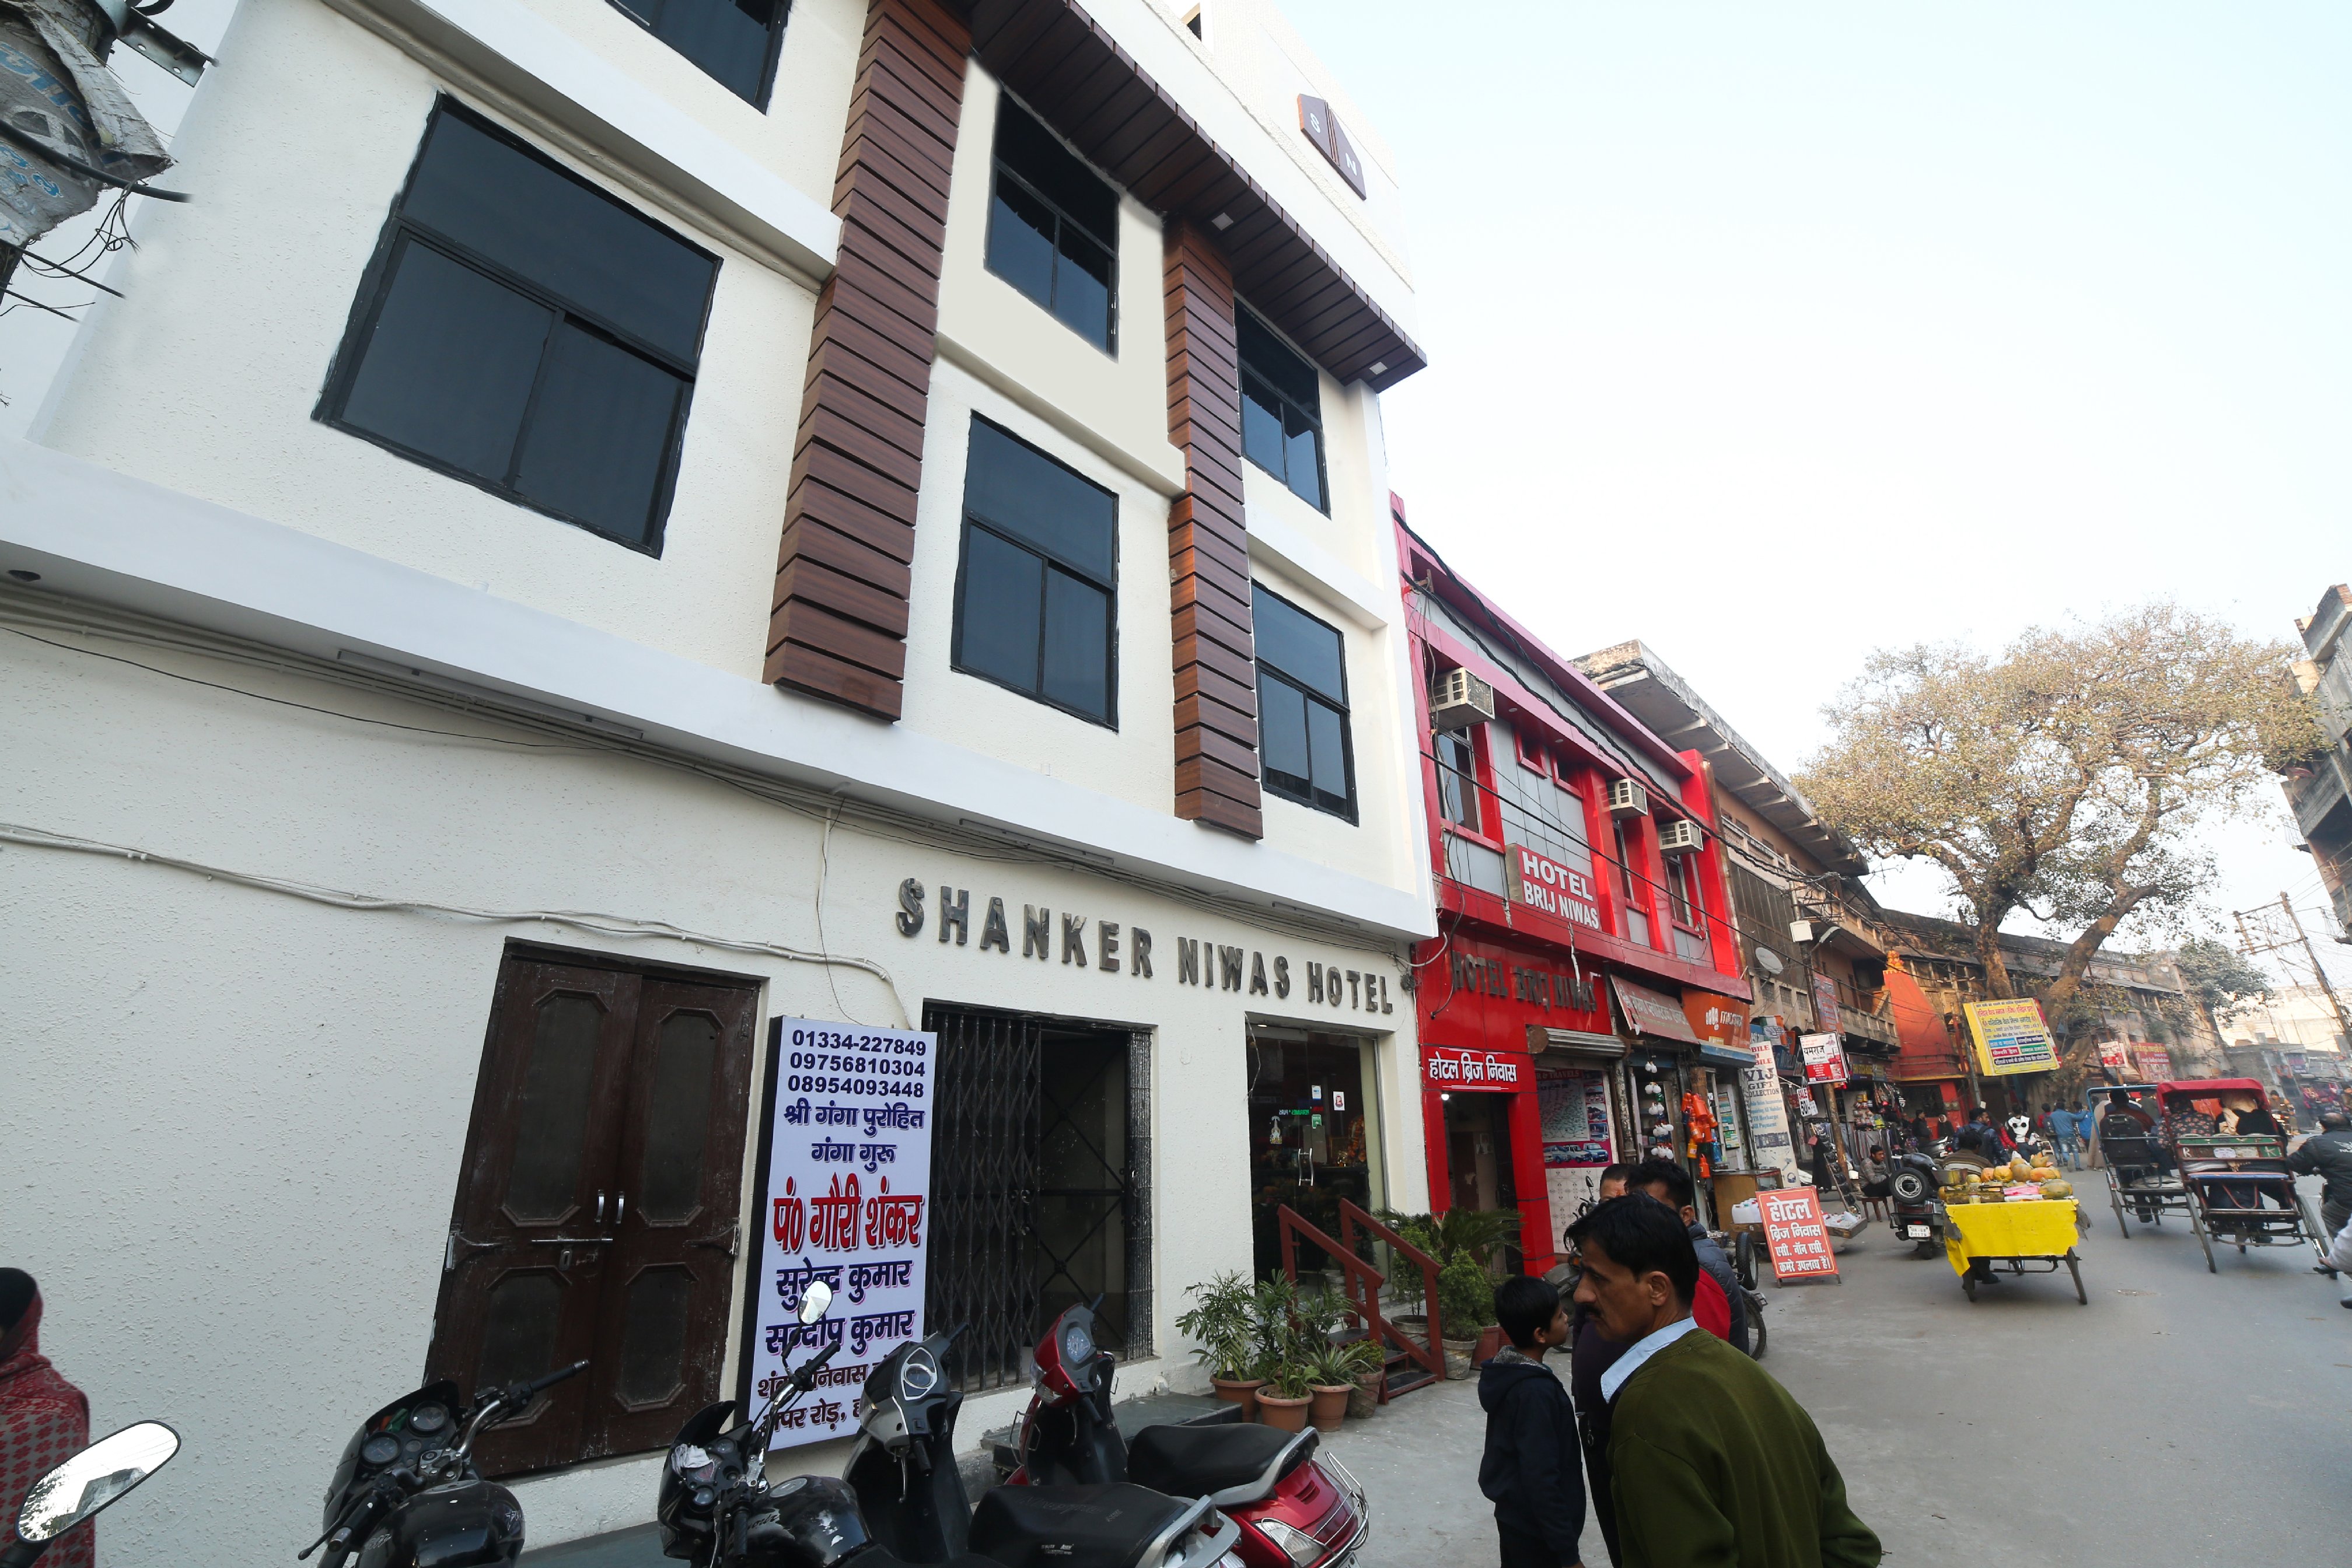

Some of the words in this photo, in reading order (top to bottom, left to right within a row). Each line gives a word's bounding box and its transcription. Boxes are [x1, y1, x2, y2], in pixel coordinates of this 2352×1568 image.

[1522, 851, 1593, 901] HOTEL
[1523, 880, 1556, 914] BRIJ
[1558, 897, 1599, 930] NIWAS
[895, 877, 1153, 978] SHANKER
[1177, 937, 1290, 998] NIWAS
[1306, 961, 1393, 1014] HOTEL
[1452, 949, 1508, 998] HOTEL
[1512, 964, 1550, 1013] BRIJ
[792, 1030, 927, 1056] 01334-227849
[790, 1052, 925, 1077] 09756810304
[1428, 1051, 1459, 1080] होटल
[1460, 1052, 1484, 1084] ब्रिज
[1486, 1055, 1518, 1083] निवास
[1743, 1068, 1775, 1080] VIJ
[788, 1074, 924, 1098] 08954093448
[1748, 1081, 1773, 1089] GIFT
[784, 1097, 811, 1126] श्री
[815, 1100, 859, 1126] गंगा
[863, 1102, 925, 1137] पुरोहित
[811, 1136, 856, 1163] गंगा
[809, 1171, 862, 1251] गौरी
[865, 1175, 924, 1248] शंकर
[1767, 1196, 1812, 1222] होटल
[1770, 1224, 1790, 1241] ब्रिज
[1791, 1222, 1822, 1238] निवास
[1793, 1241, 1807, 1255] नॉन
[1778, 1259, 1795, 1273] कमरे
[1796, 1259, 1820, 1271] उपलब्ध
[848, 1260, 913, 1304] कुमार
[850, 1310, 915, 1357] कुमार
[1283, 1449, 1299, 1464] ONDA
